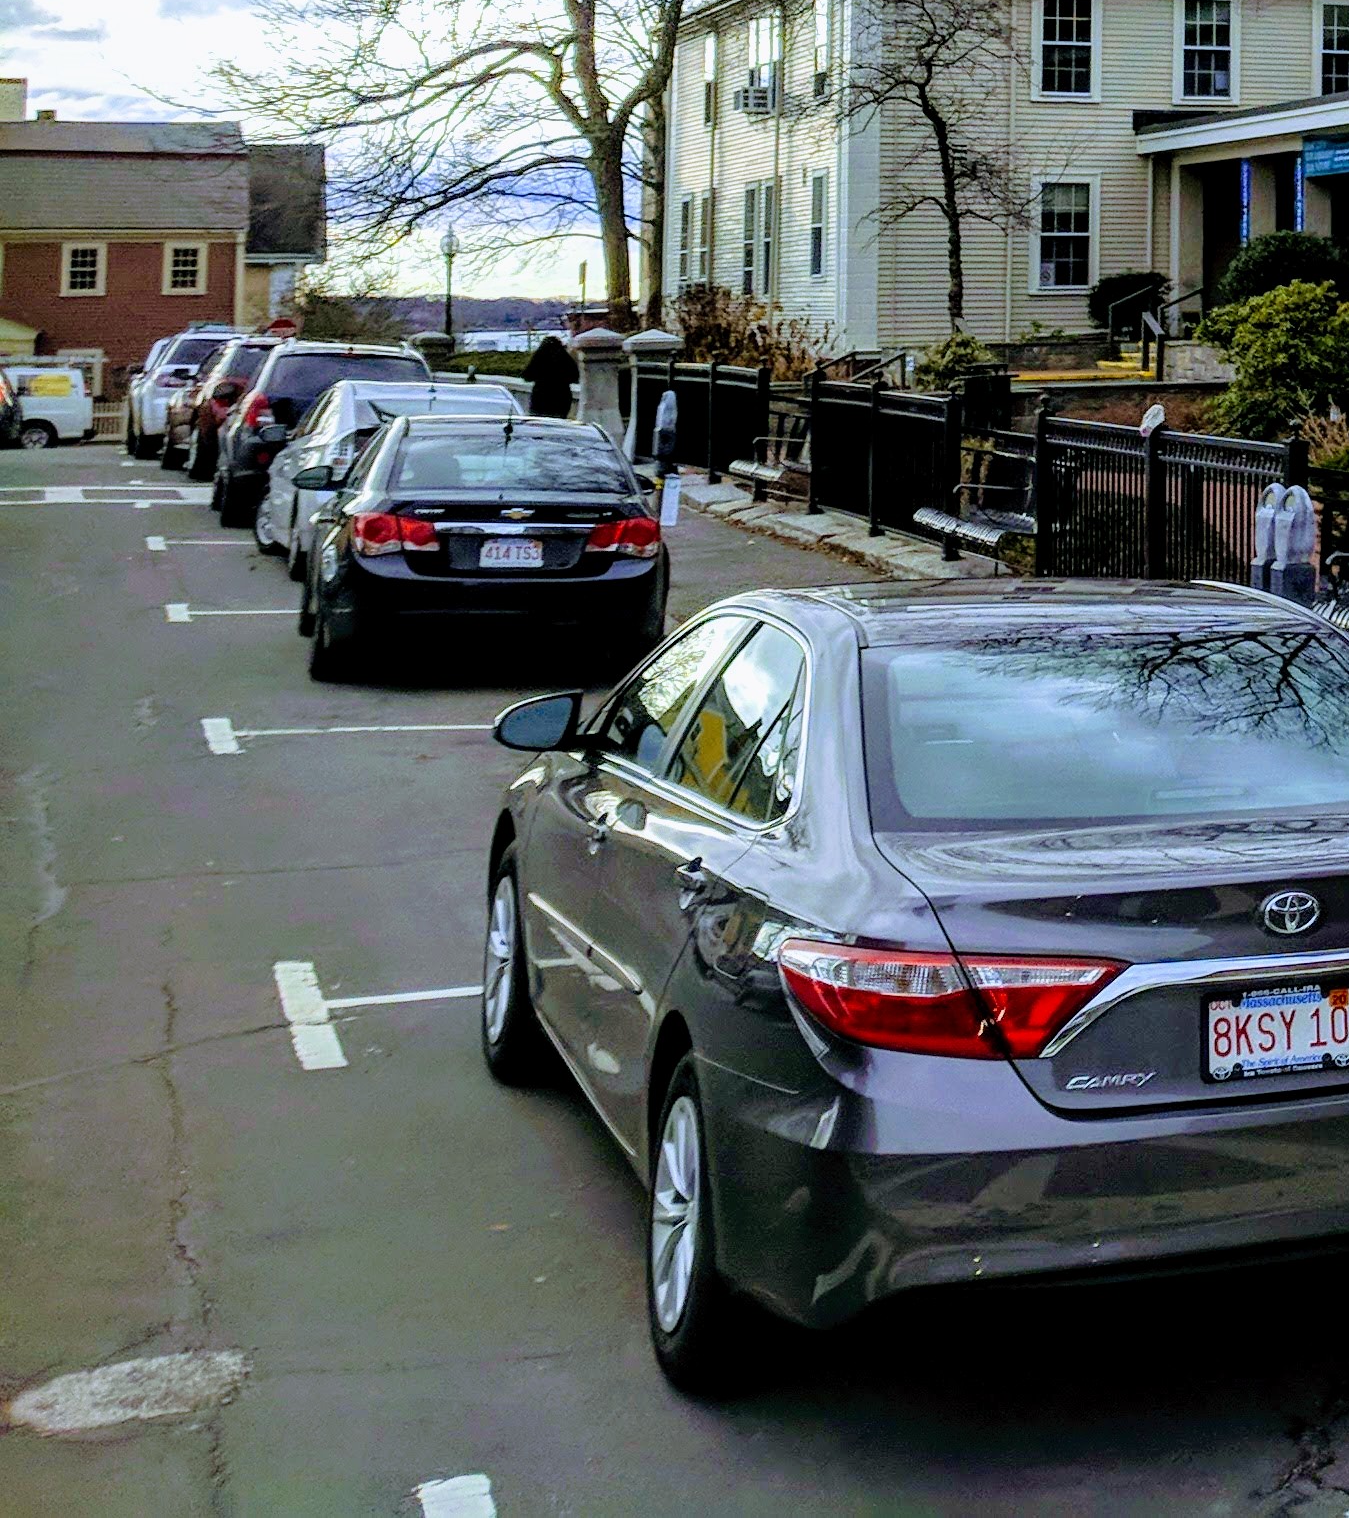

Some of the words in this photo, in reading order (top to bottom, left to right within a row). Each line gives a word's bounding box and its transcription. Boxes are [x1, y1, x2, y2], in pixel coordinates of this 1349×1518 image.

[1332, 994, 1347, 1006] 20
[1213, 1009, 1296, 1057] 8KSY
[1310, 1006, 1349, 1048] 10
[1065, 1072, 1158, 1090] CAMRY
